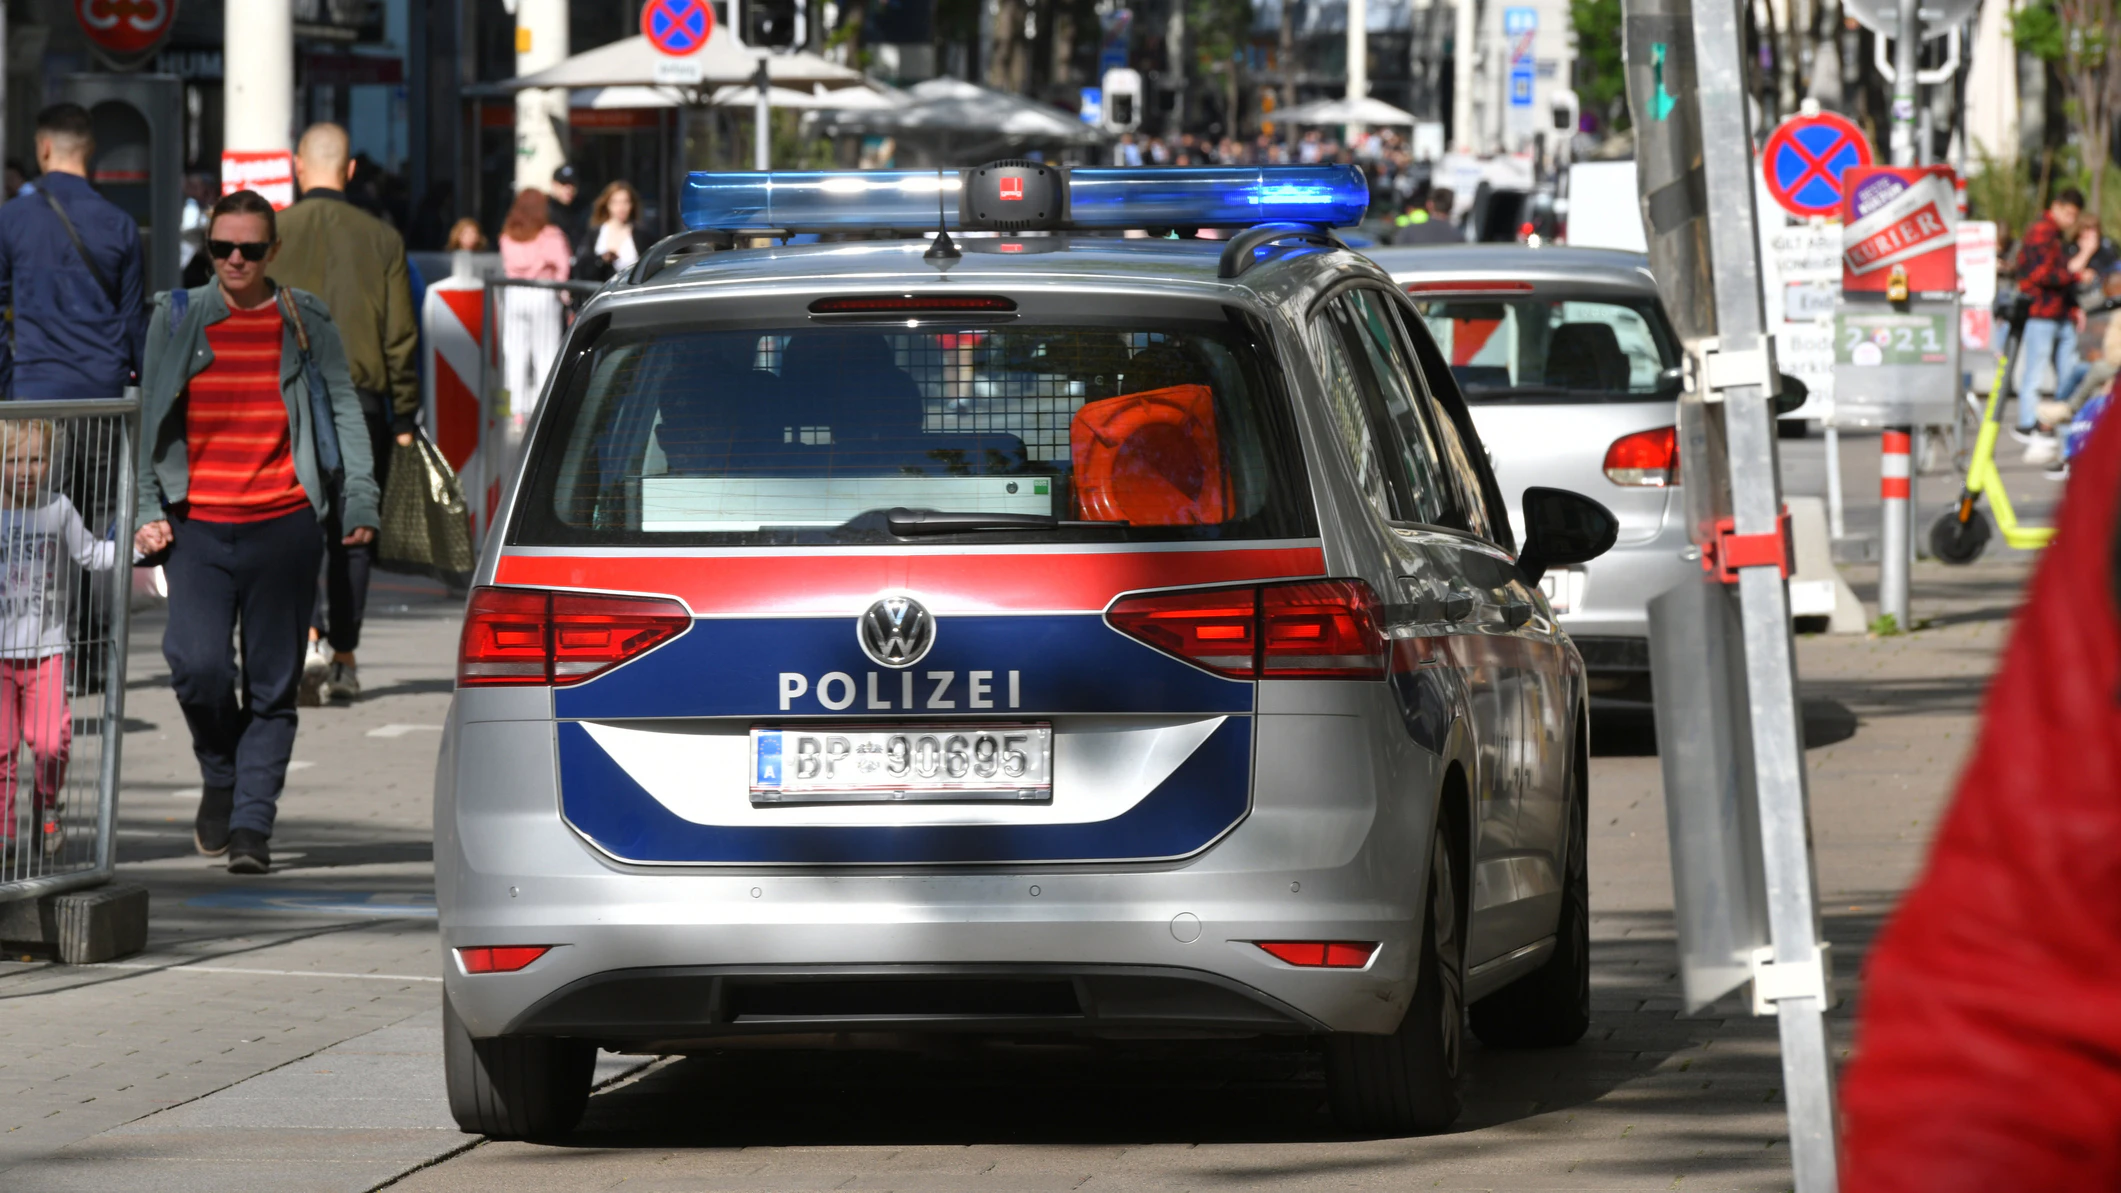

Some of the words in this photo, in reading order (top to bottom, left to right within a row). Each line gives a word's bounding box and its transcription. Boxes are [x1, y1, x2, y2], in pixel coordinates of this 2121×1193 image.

[1850, 211, 1942, 266] KURIER
[779, 670, 1020, 710] POLIZEI
[763, 766, 776, 779] A
[797, 736, 849, 780] BP
[885, 733, 1028, 778] 90695
